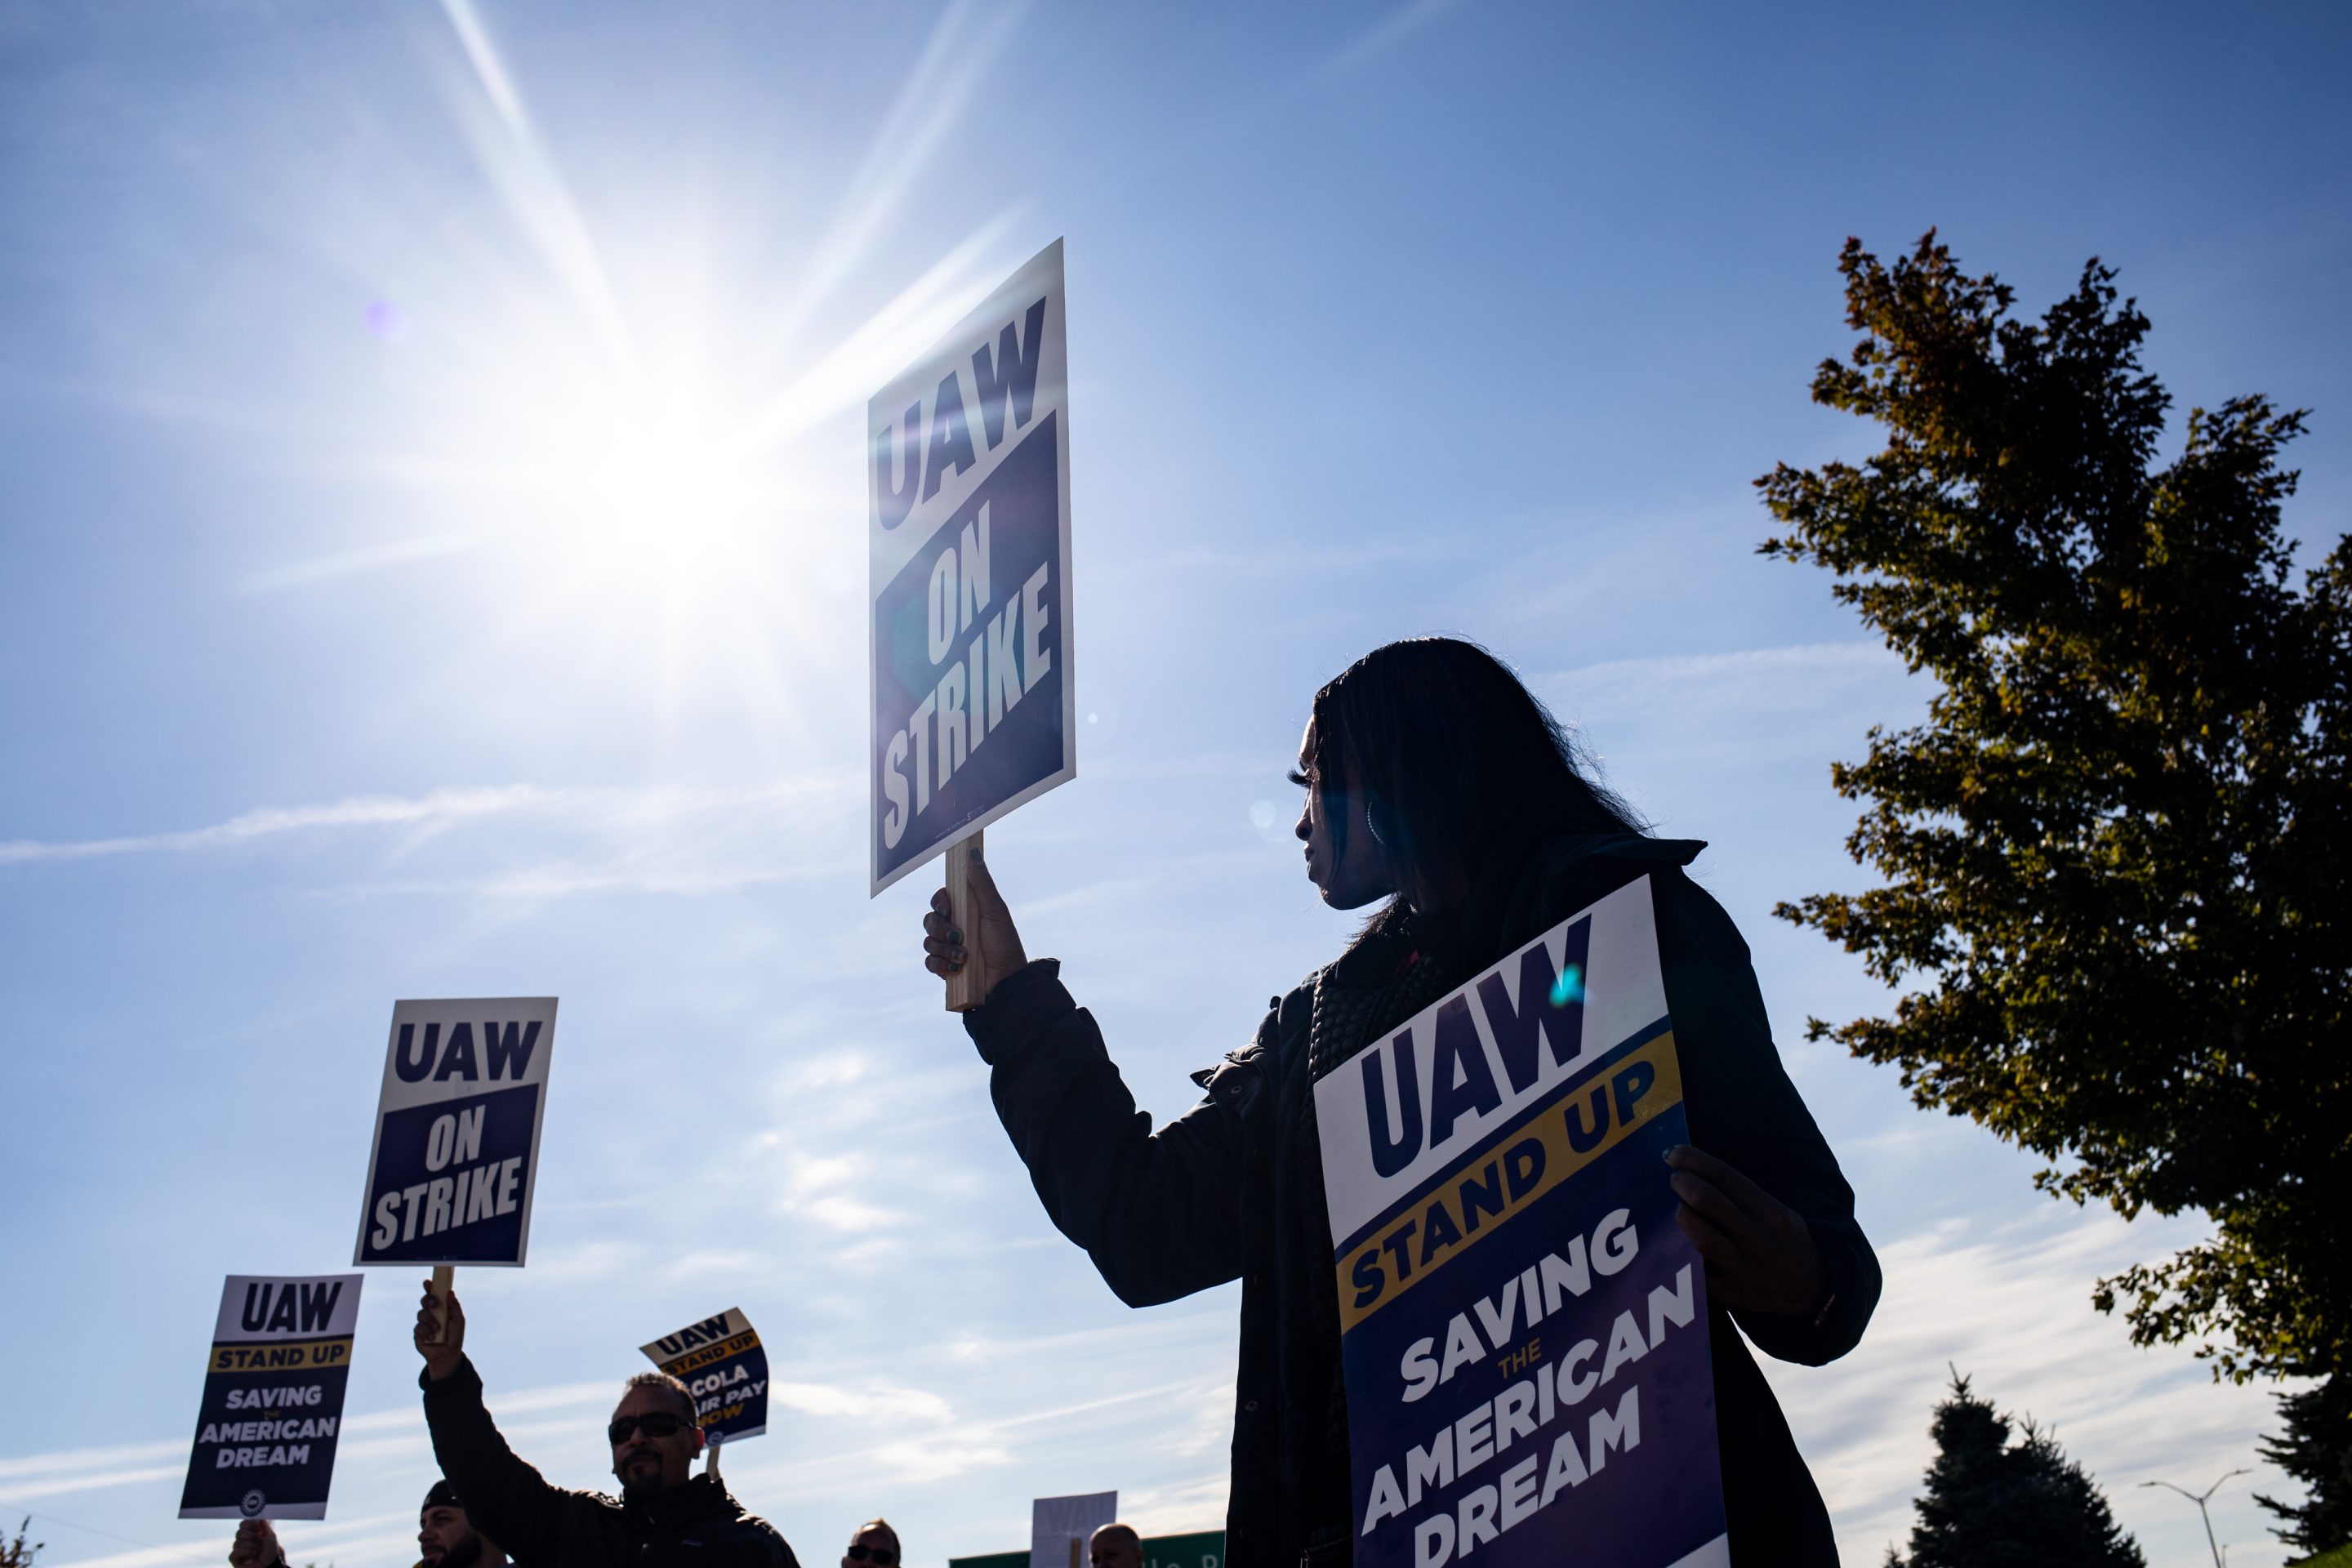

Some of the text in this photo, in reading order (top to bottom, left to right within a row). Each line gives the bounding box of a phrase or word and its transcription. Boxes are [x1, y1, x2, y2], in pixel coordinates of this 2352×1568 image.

[877, 296, 1046, 531] UAW
[929, 500, 990, 666] ON
[884, 561, 1050, 849] STRIKE
[395, 1022, 543, 1083] UAW
[1361, 913, 1592, 1178] UAW
[425, 1104, 486, 1172] ON
[372, 1156, 523, 1250] STRIKE
[1352, 1061, 1655, 1308] STAND UP
[242, 1281, 343, 1333] UAW
[657, 1314, 730, 1355] UAW
[1401, 1209, 1639, 1402] SAVING
[216, 1344, 345, 1369] STAND UP
[666, 1335, 754, 1374] STAND UP
[691, 1364, 749, 1396] COLA
[1498, 1338, 1541, 1380] THE
[225, 1385, 322, 1410] SAVING
[725, 1379, 766, 1405] PAY
[1361, 1263, 1695, 1537] AMERICAN
[198, 1417, 336, 1444] AMERICAN
[216, 1445, 310, 1468] DREAM
[1414, 1385, 1640, 1568] DREAM
